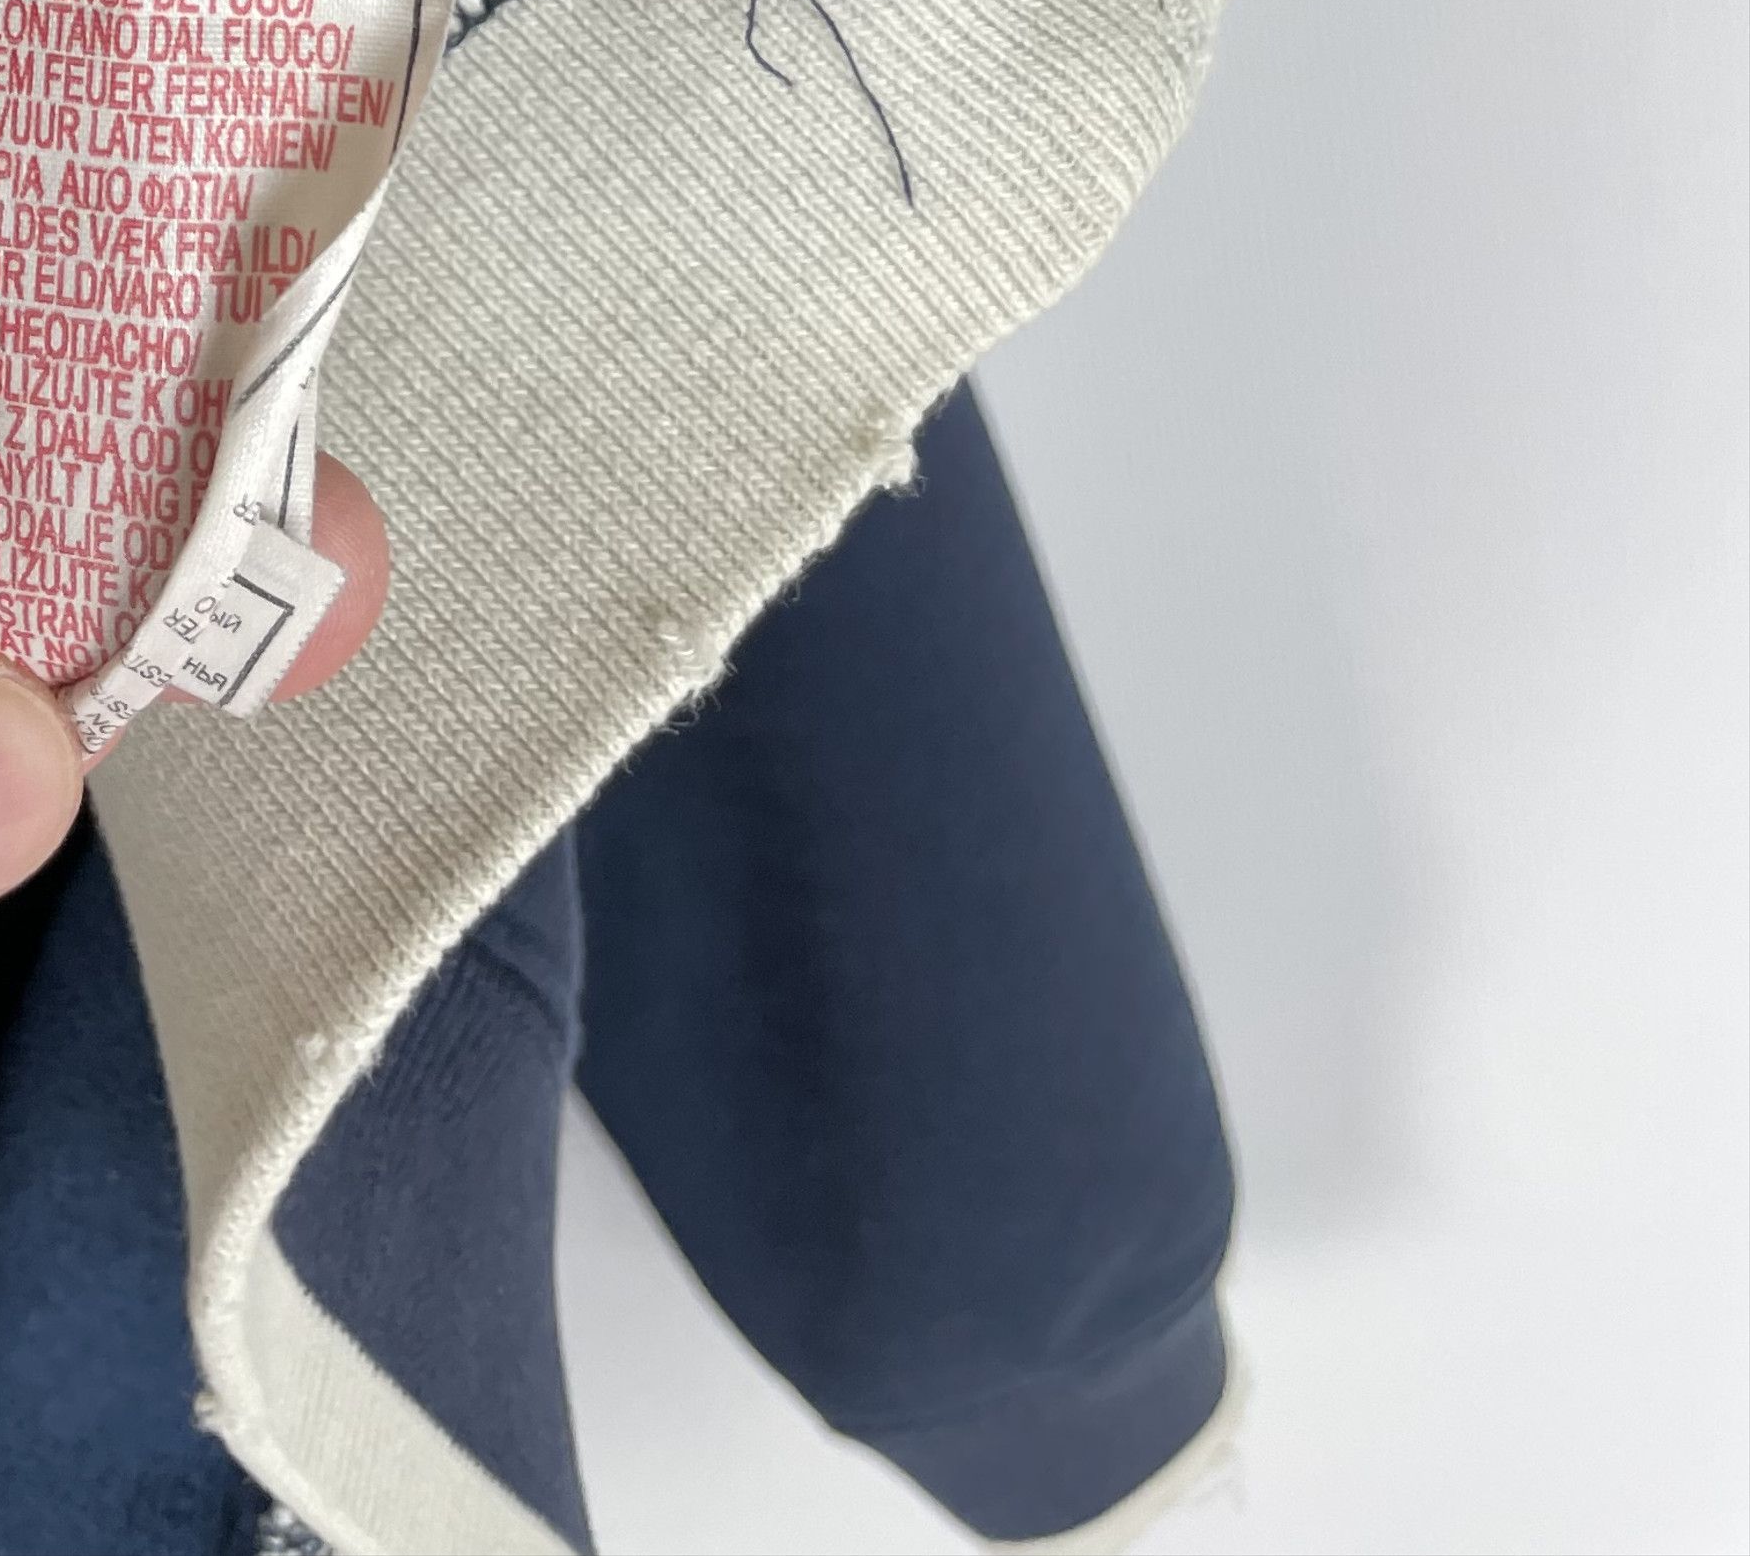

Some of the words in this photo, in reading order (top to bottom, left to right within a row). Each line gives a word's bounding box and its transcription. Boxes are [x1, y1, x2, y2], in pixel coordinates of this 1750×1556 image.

[148, 15, 213, 63] DAL
[223, 18, 355, 71] FUOCO/
[43, 52, 155, 113] FEUER
[164, 66, 394, 128] FERNHALTEN/
[87, 110, 194, 166] LATEN
[205, 119, 338, 172] KOMEN/
[89, 213, 168, 270] VÆK
[176, 222, 243, 274] FRA
[251, 224, 317, 275] ILD/
[142, 377, 166, 426] K
[3, 404, 28, 451] Z
[35, 409, 122, 464] DALA
[129, 424, 181, 475] OD
[123, 520, 174, 572] OD
